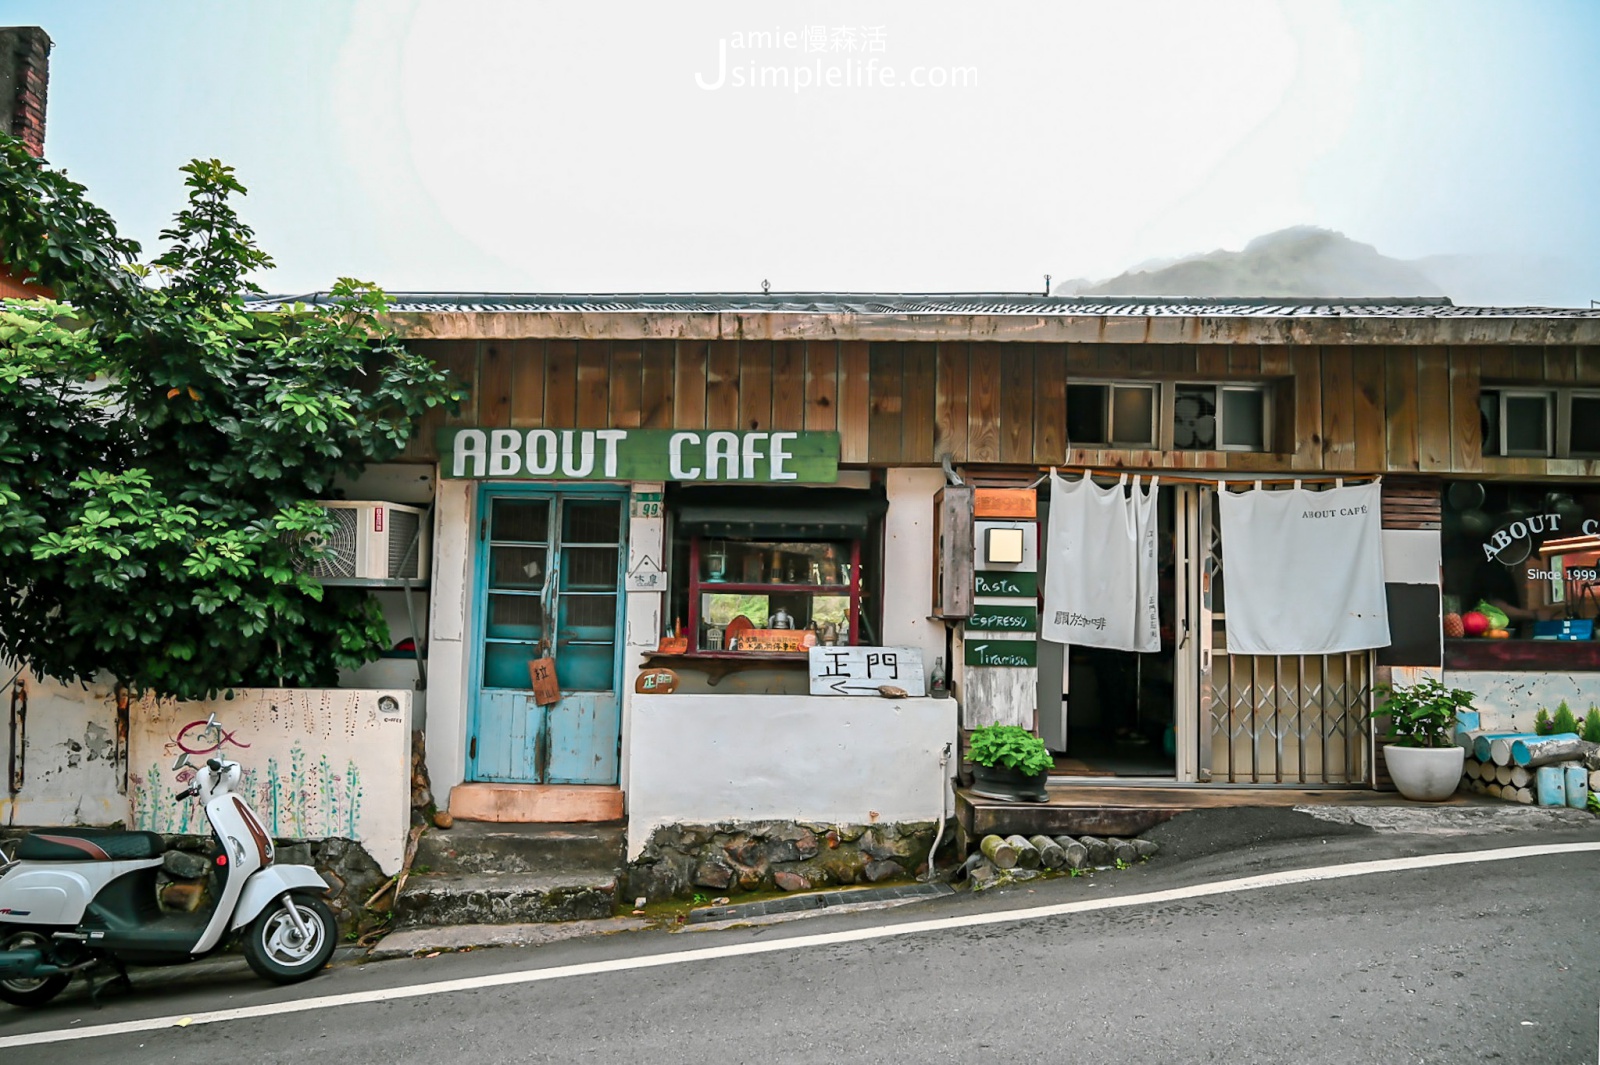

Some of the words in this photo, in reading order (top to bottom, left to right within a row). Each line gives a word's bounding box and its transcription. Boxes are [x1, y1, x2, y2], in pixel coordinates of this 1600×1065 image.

[453, 429, 628, 478] ABOUT
[669, 431, 798, 480] CAFE
[642, 503, 658, 516] 99
[1302, 509, 1336, 518] ABOUT
[1340, 504, 1368, 516] CAFÉ
[1482, 513, 1561, 562] ABOUT
[1527, 568, 1561, 580] Since
[1566, 569, 1597, 581] 1999
[975, 577, 1020, 593] Pasta
[974, 644, 1029, 666] Tiramisu
[818, 652, 898, 681] 正門
[642, 673, 673, 689] 正門
